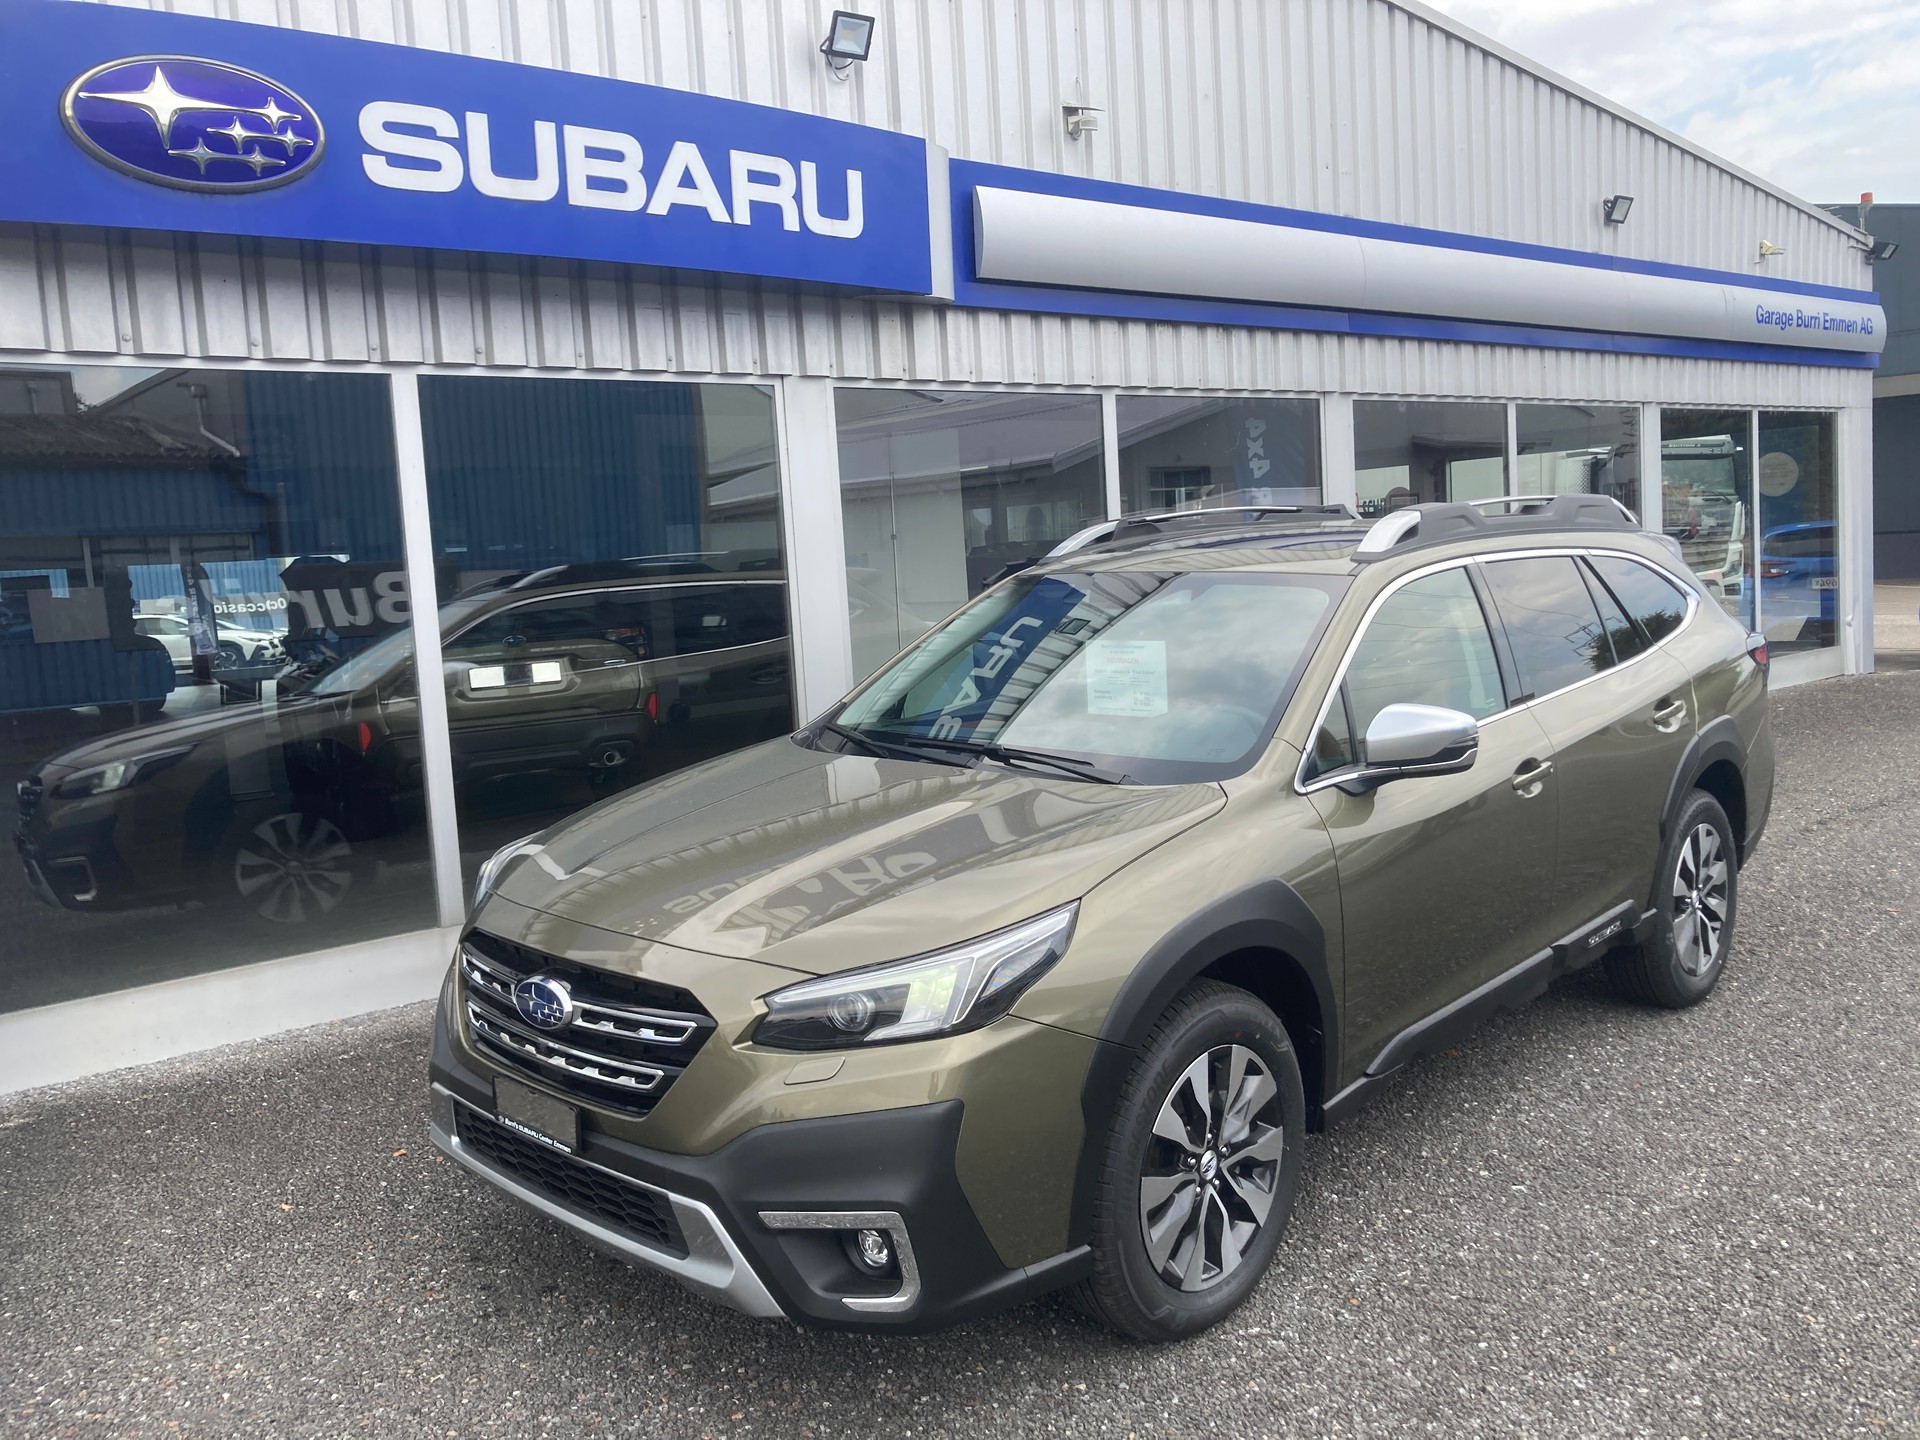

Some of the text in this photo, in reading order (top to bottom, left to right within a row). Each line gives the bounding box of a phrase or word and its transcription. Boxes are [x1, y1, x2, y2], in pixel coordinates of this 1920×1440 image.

[358, 101, 865, 240] SUBARU
[1756, 304, 1873, 335] Garage Burri Emmen AG
[553, 1140, 572, 1153] Emmen
